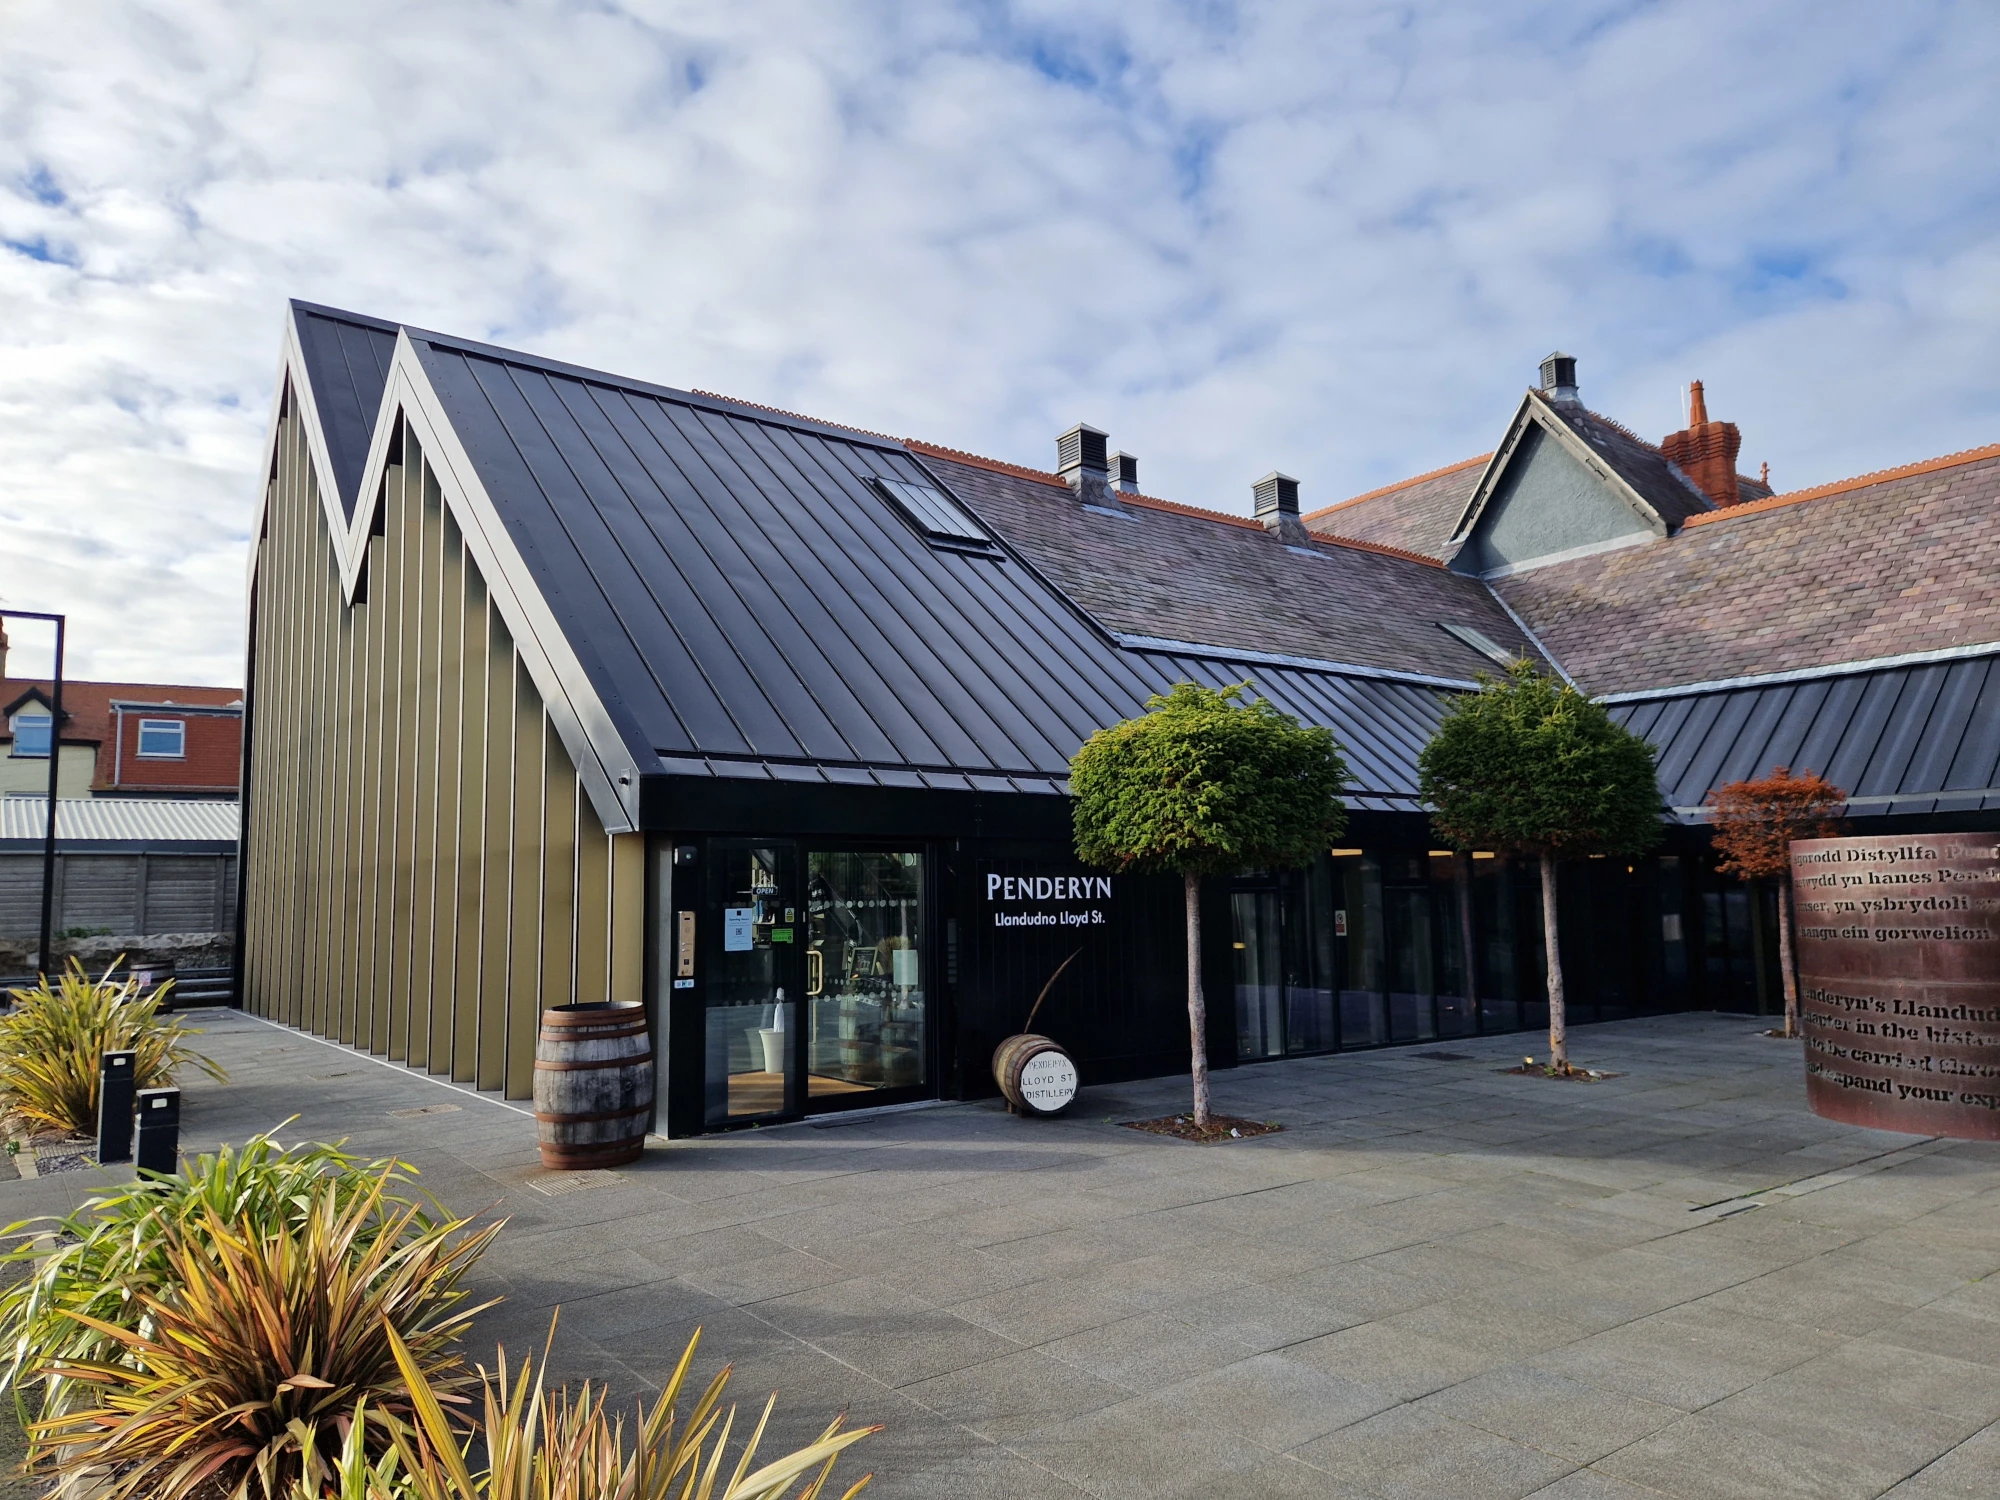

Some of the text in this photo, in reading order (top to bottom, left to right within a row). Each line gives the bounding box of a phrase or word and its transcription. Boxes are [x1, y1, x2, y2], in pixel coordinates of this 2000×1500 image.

[1847, 847, 1937, 864] Distyllfa
[987, 873, 1111, 900] PENDERYN
[1840, 876, 1863, 888] yn
[1868, 872, 1932, 885] hanes
[1834, 900, 1855, 914] yn
[1861, 897, 1969, 914] ysbrydoli
[995, 910, 1105, 927] Llandudno Lloyd St.
[1842, 926, 1869, 939] ein
[1803, 987, 1885, 1013] enderyn's
[1856, 1018, 1876, 1035] in
[1881, 1022, 1919, 1040] the
[1851, 1049, 1933, 1072] carried
[1022, 1073, 1073, 1085] LLOYD ST
[1026, 1088, 1074, 1099] DISTILLERY
[1897, 1084, 1953, 1100] your
